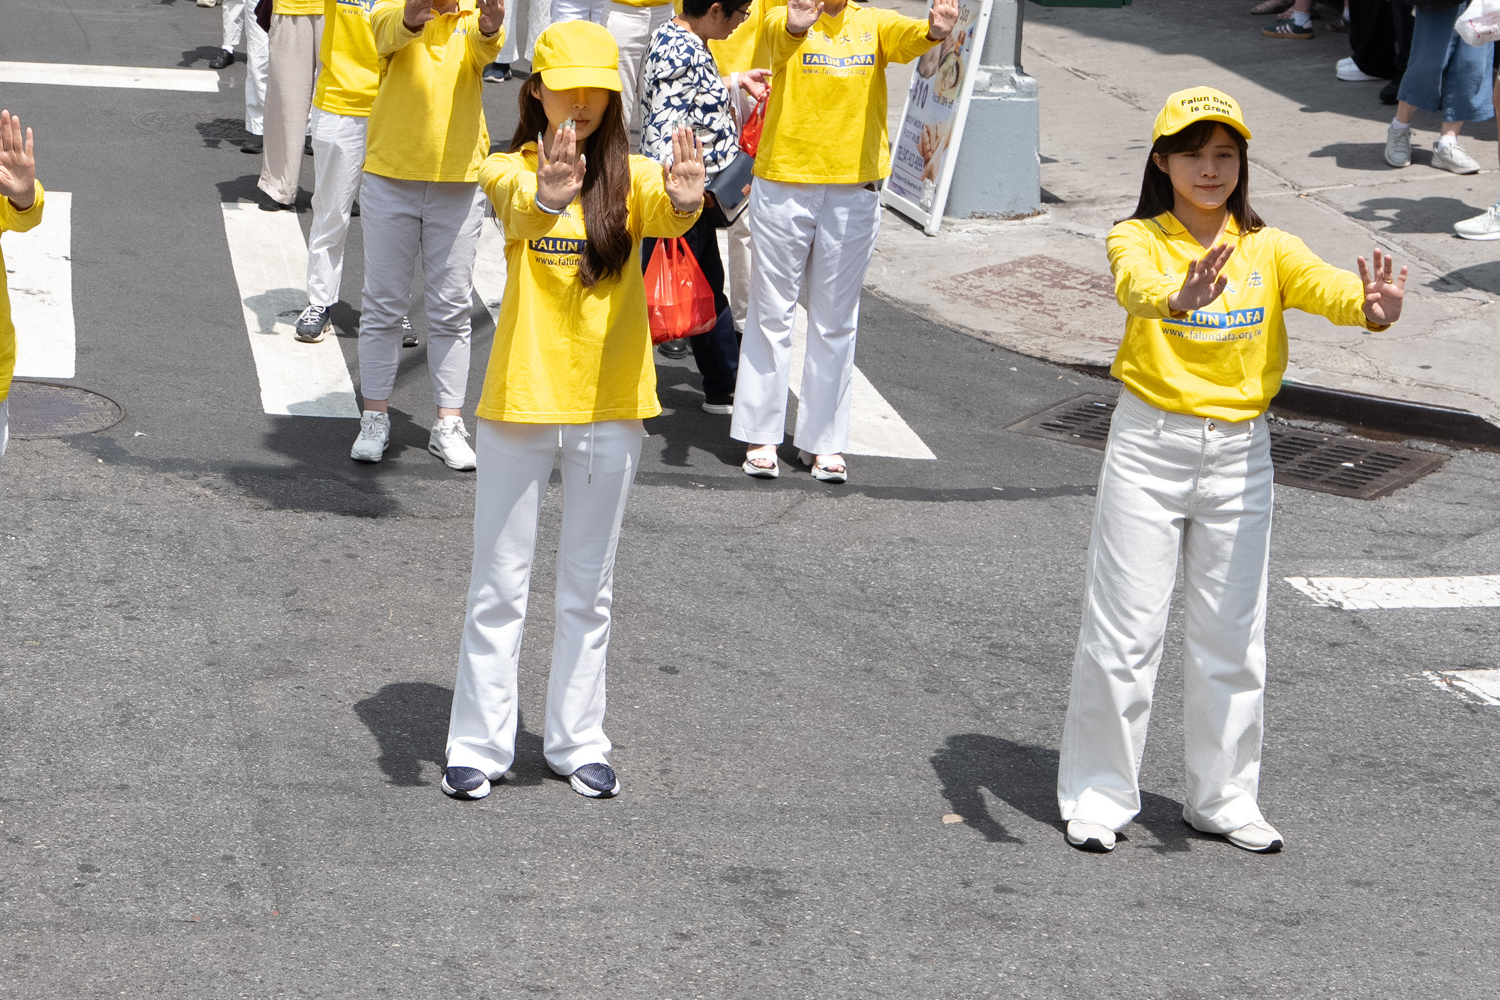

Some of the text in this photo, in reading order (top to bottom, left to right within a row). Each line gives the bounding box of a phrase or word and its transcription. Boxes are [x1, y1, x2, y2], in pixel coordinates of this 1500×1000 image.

[805, 54, 875, 66] FALUN DAFA
[1181, 96, 1233, 109] Falun Dafa
[1203, 104, 1231, 116] Great
[531, 239, 579, 252] FALUN
[535, 255, 582, 266] www.falun
[1225, 309, 1262, 326] DAFA
